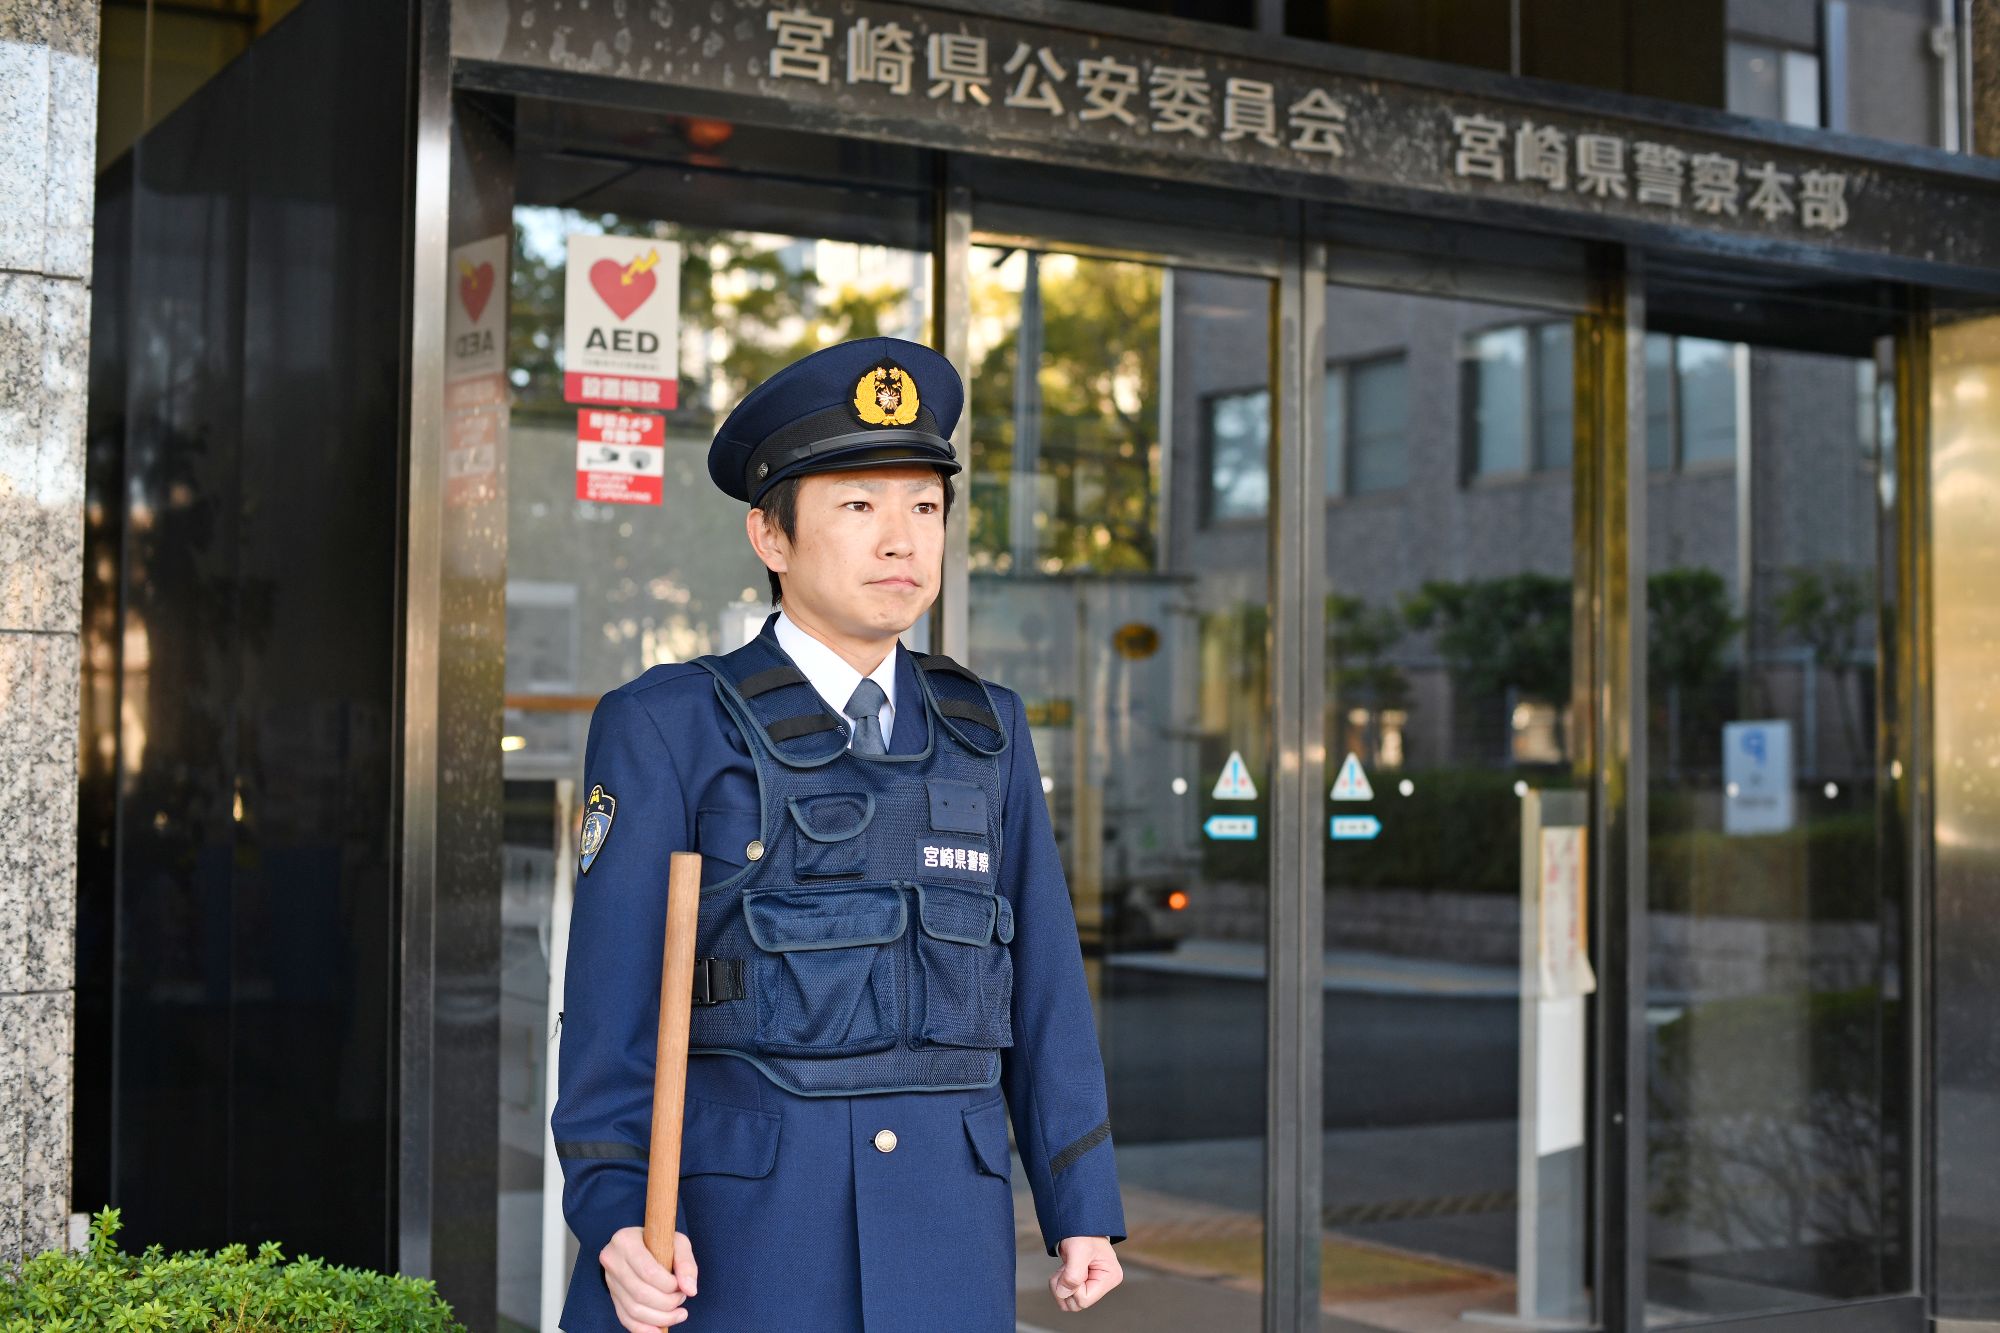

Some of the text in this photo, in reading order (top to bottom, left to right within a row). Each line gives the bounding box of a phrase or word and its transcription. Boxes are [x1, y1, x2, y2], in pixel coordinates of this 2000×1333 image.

[766, 9, 1347, 158] 宮崎県公安委員会
[1452, 113, 1850, 231] 宮崎県警察本部
[585, 327, 659, 354] AED
[923, 845, 988, 873] 宮崎県警察
